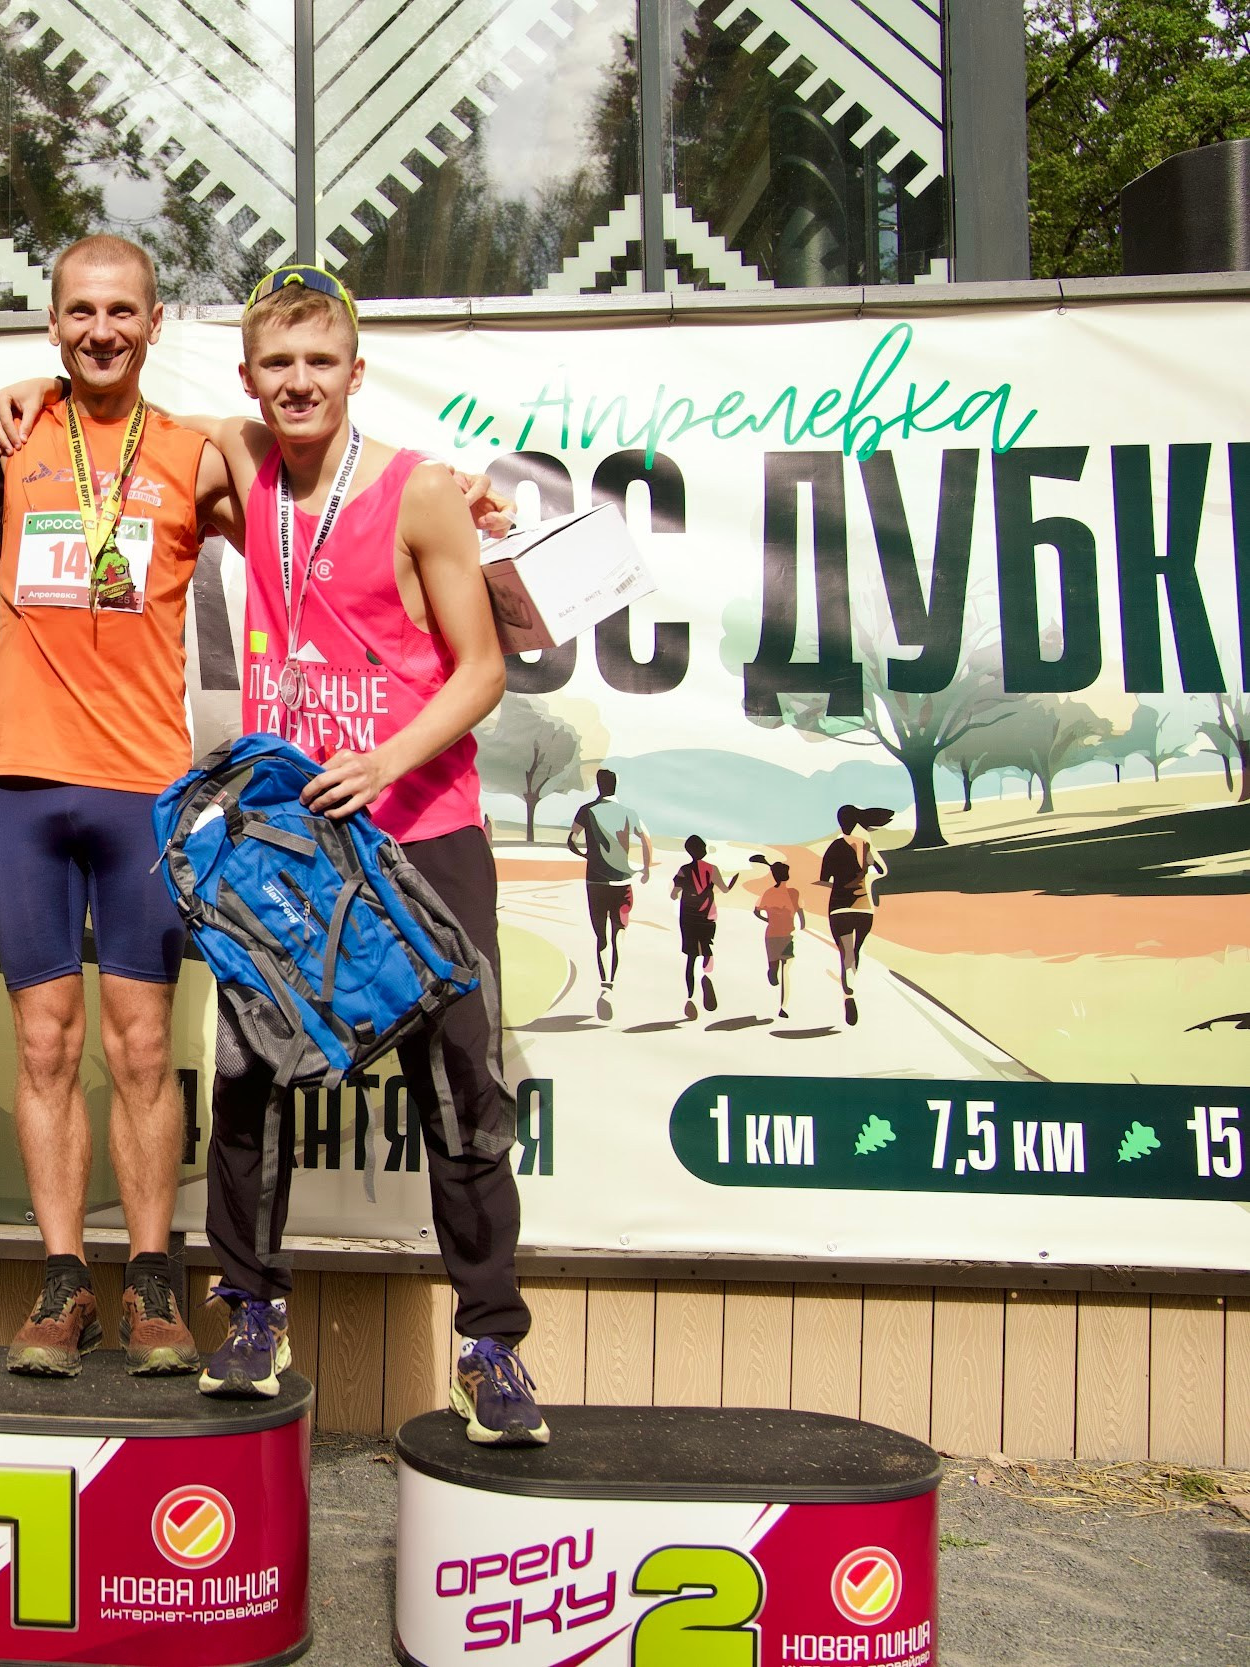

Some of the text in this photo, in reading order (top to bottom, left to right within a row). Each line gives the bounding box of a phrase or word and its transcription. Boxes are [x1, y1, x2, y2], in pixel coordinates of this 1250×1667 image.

[515, 322, 1038, 470] Апрелевка
[72, 440, 87, 483] ГОРОДСКОЙ
[80, 484, 92, 508] ОКРУГ
[335, 444, 359, 493] ГОРОДСКОЙ
[280, 504, 290, 559] ГОРОДСКОЙ
[28, 591, 78, 600] Апрелевка
[257, 704, 376, 751] ГАНТЕЛИ
[280, 900, 300, 924] Feng
[710, 1094, 729, 1164] 1
[926, 1100, 997, 1175] 7,5
[1187, 1105, 1244, 1178] 15
[100, 1566, 279, 1606] НОВАЯ ЛИНИЯ
[630, 1544, 766, 1667] 2
[100, 1597, 280, 1626] интернет-провайдер
[464, 1570, 617, 1652] SKY
[781, 1634, 869, 1661] НОВАЯ
[875, 1620, 931, 1659] ЛИНИЯ
